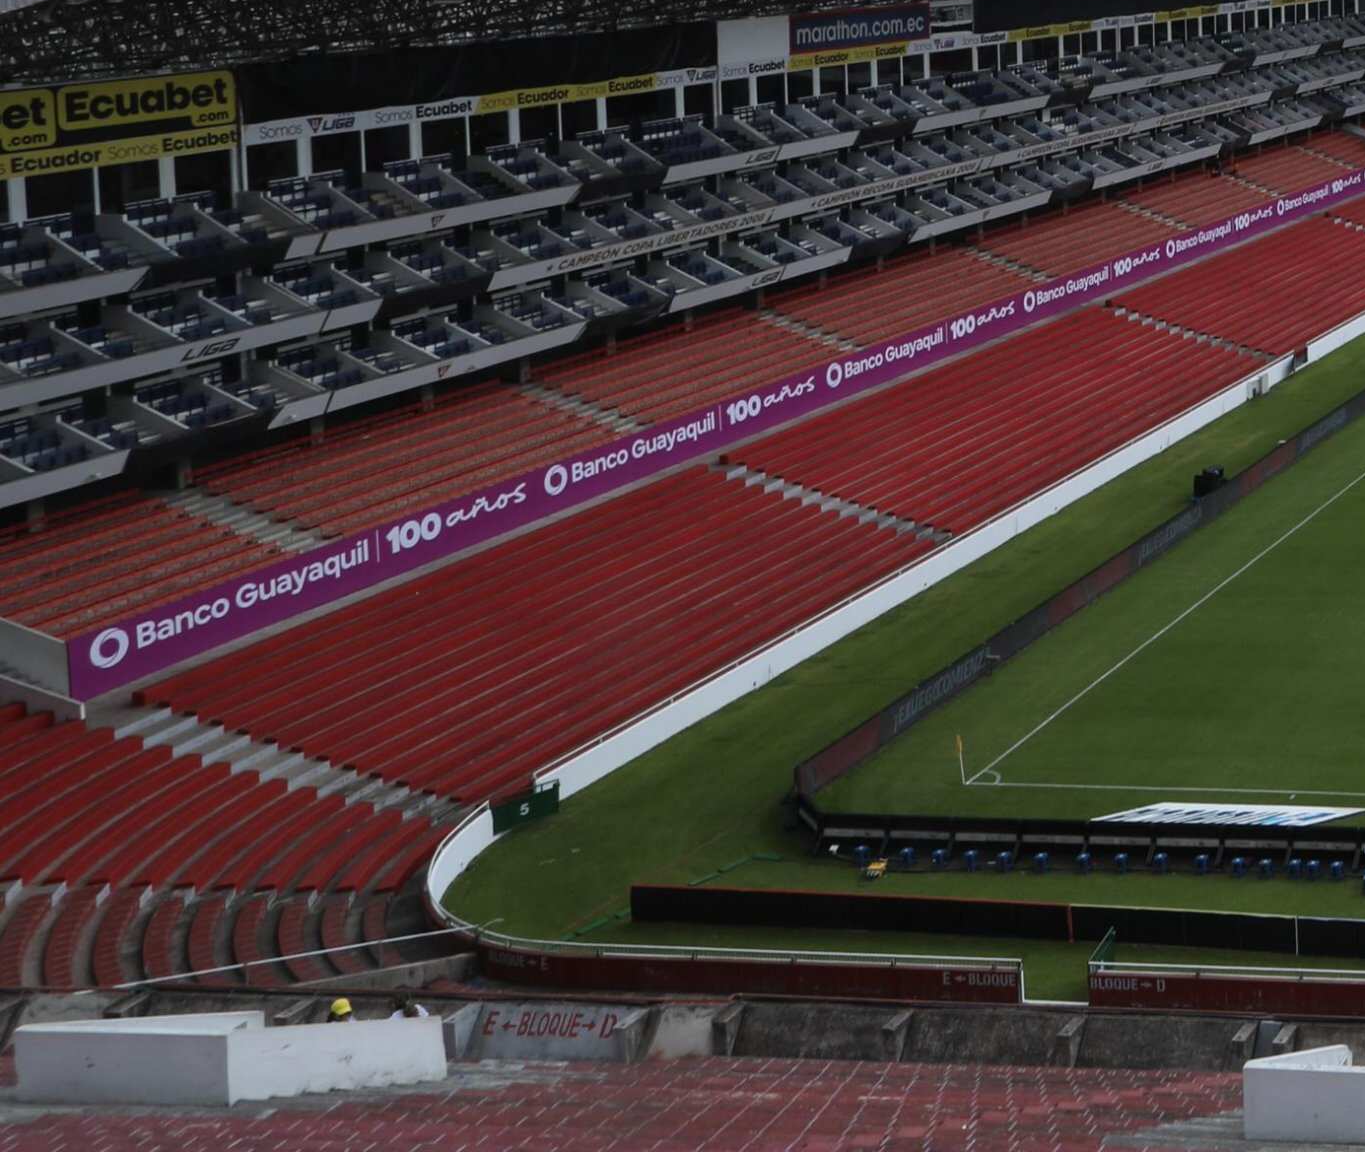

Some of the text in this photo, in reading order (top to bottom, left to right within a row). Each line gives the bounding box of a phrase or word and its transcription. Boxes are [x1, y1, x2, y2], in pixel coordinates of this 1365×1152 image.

[796, 18, 924, 45] marathon.com.ec
[65, 78, 228, 123] Ecuabet
[11, 150, 101, 174] Ecuador
[107, 146, 158, 161] Somos
[162, 129, 241, 153] Ecuabet
[259, 124, 302, 140] Somos
[322, 116, 355, 131] LIGA
[375, 109, 413, 124] Somos
[416, 100, 472, 118] Ecuabet
[517, 88, 569, 105] Ecuador
[608, 75, 653, 92] Ecuabet
[749, 60, 785, 74] Ecuabet
[196, 109, 229, 123] .com
[182, 338, 240, 361] LIGA
[136, 598, 230, 649] Banco
[235, 538, 369, 609] Guayaquil
[386, 512, 442, 554] 100
[571, 449, 628, 483] Banco
[632, 412, 715, 459] Guayaquil
[726, 395, 763, 425] 100
[763, 375, 816, 407] años
[844, 354, 883, 379] Banco
[885, 328, 943, 363] Guayaquil
[950, 314, 976, 341] 100
[1036, 286, 1065, 306] Banco
[1066, 267, 1109, 295] Guayaquil
[1114, 257, 1132, 277] 100
[1175, 236, 1198, 254] Banco
[1198, 222, 1231, 244] Guayaquil
[1234, 213, 1250, 232] 100
[520, 802, 530, 816] 5
[943, 972, 1016, 987] E BLOQUE
[1090, 977, 1165, 992] BLOQUE D
[483, 1011, 500, 1036] E
[517, 1011, 583, 1038] BLOQUE
